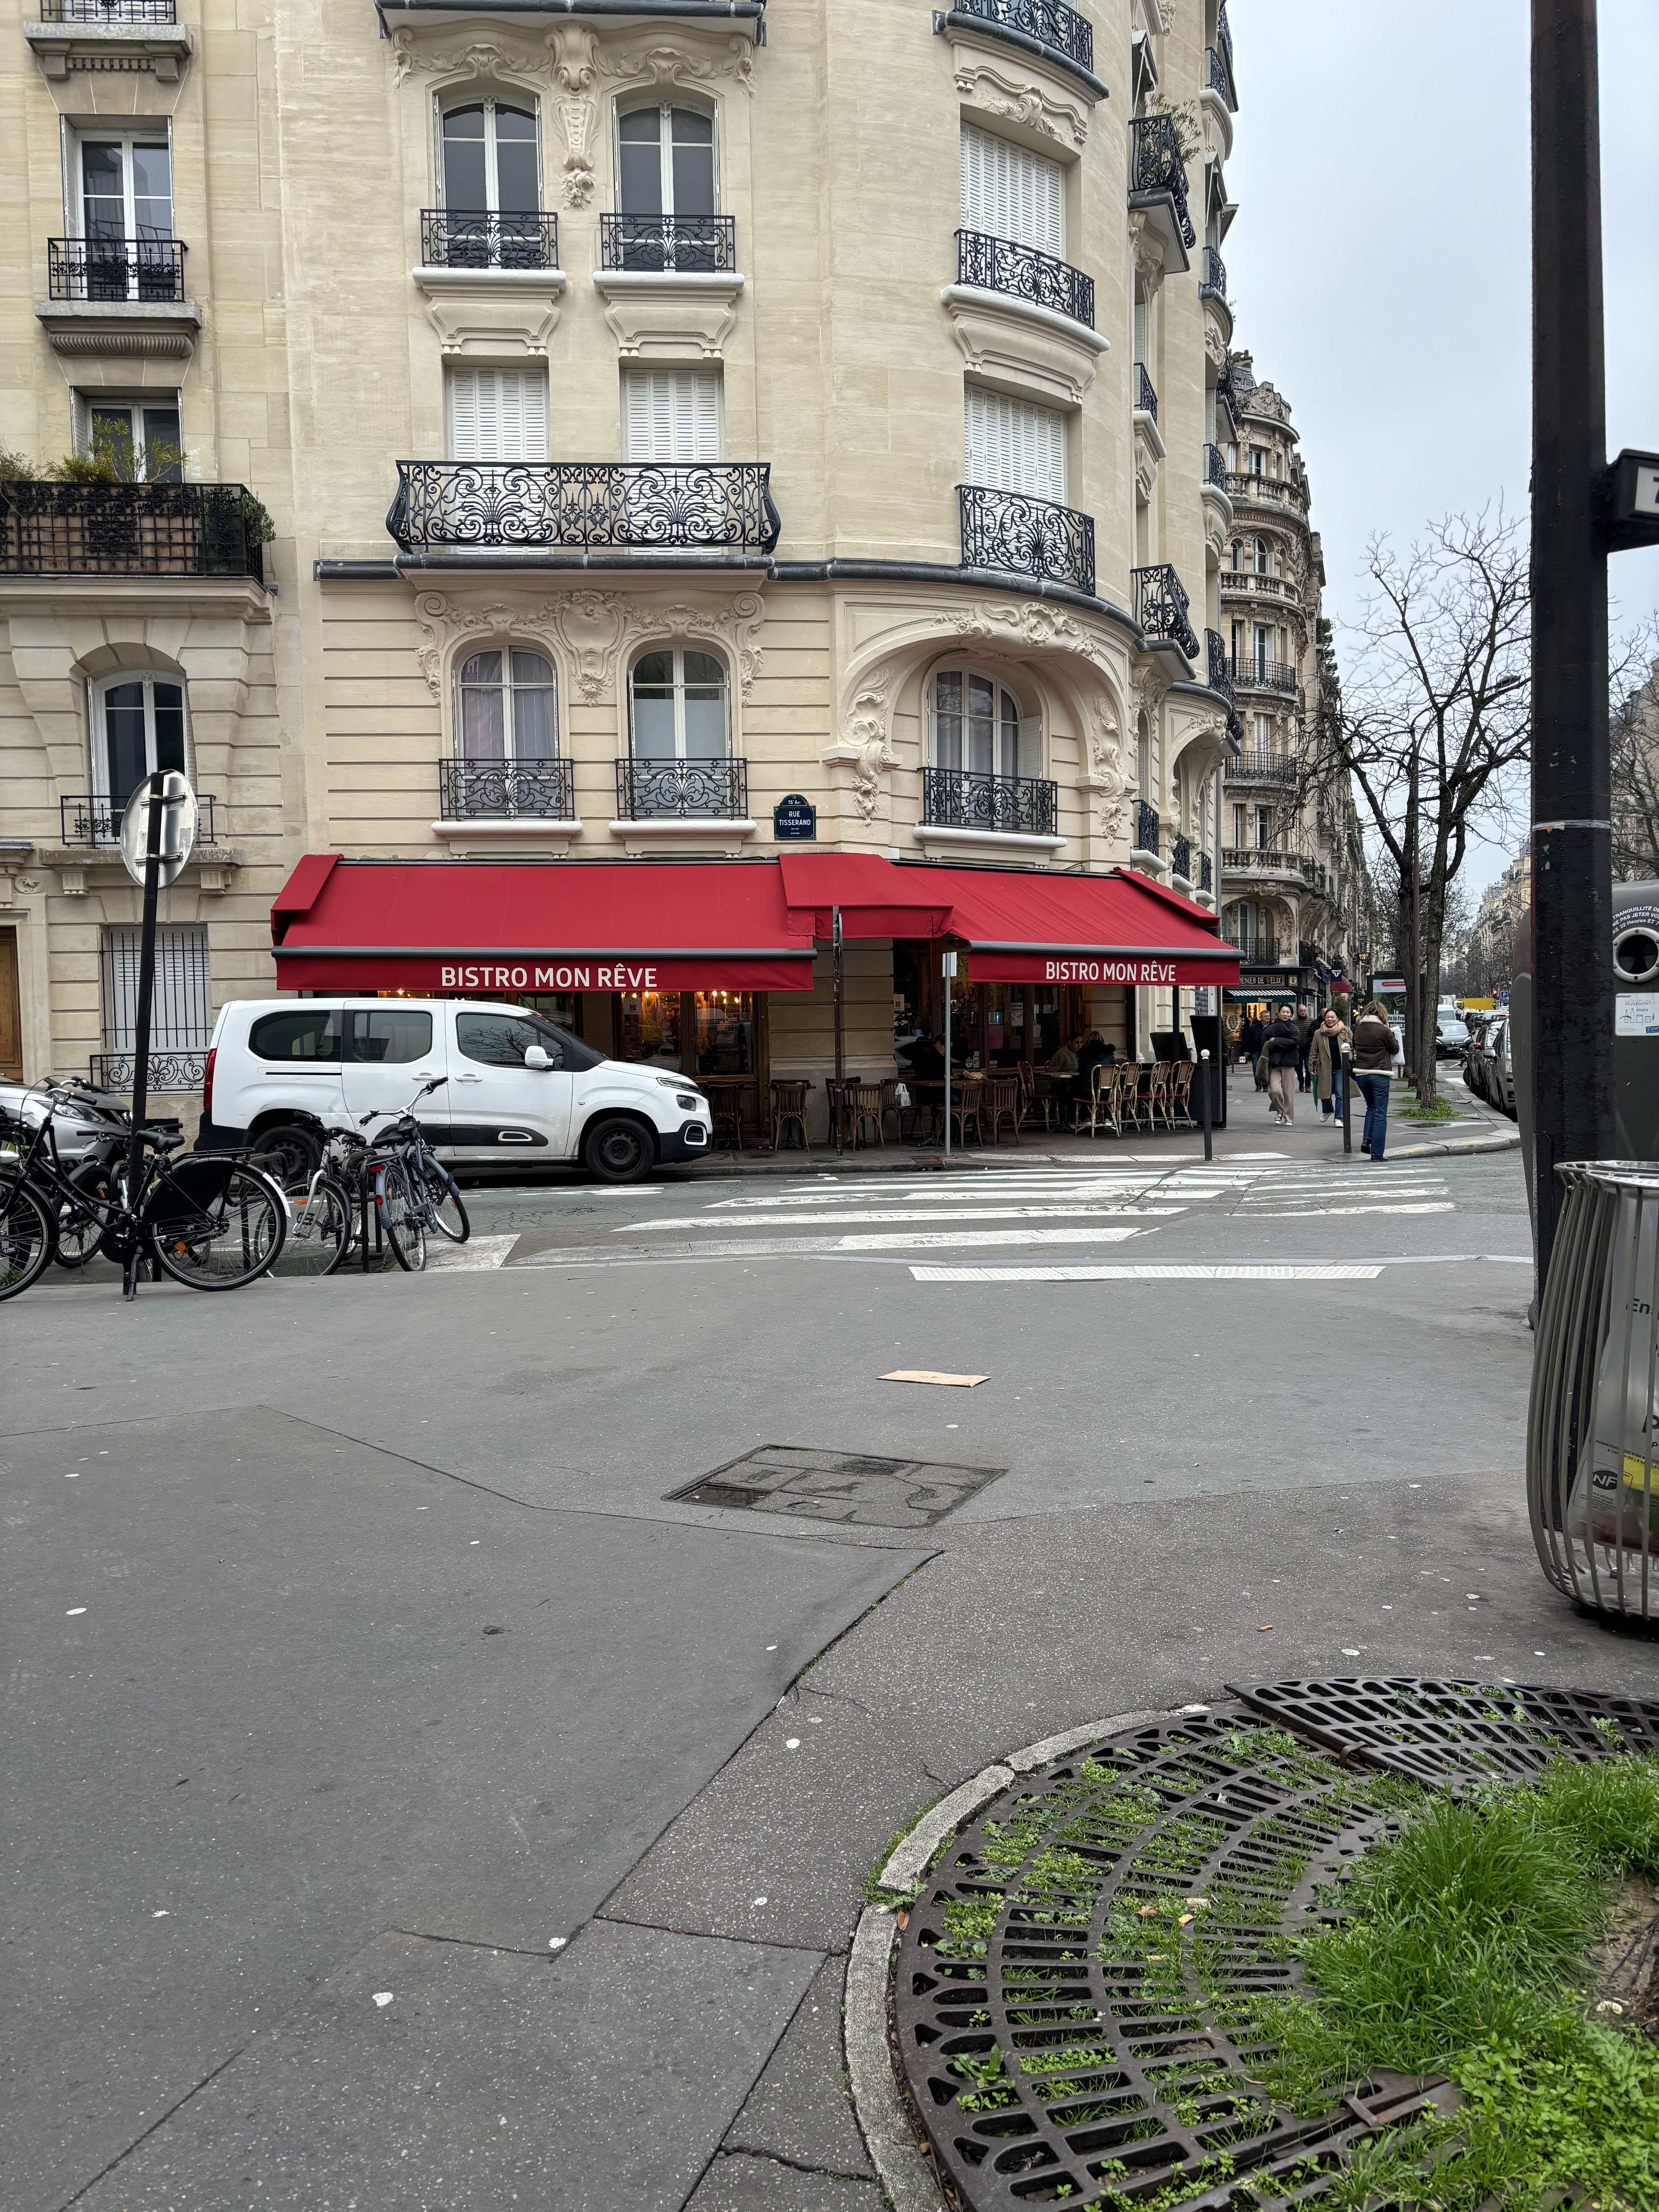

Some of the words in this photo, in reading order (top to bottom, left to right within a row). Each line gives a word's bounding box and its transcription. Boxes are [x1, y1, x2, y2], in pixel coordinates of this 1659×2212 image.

[1612, 906, 1652, 919] TRANQUILLITÉ
[441, 967, 527, 987] BISTRO
[535, 967, 590, 987] MON
[598, 963, 657, 988] RÊVE
[1046, 961, 1099, 981] BISTRO
[1103, 963, 1137, 981] MON
[1141, 960, 1176, 982] RÊVE
[1592, 1474, 1618, 1487] NF
